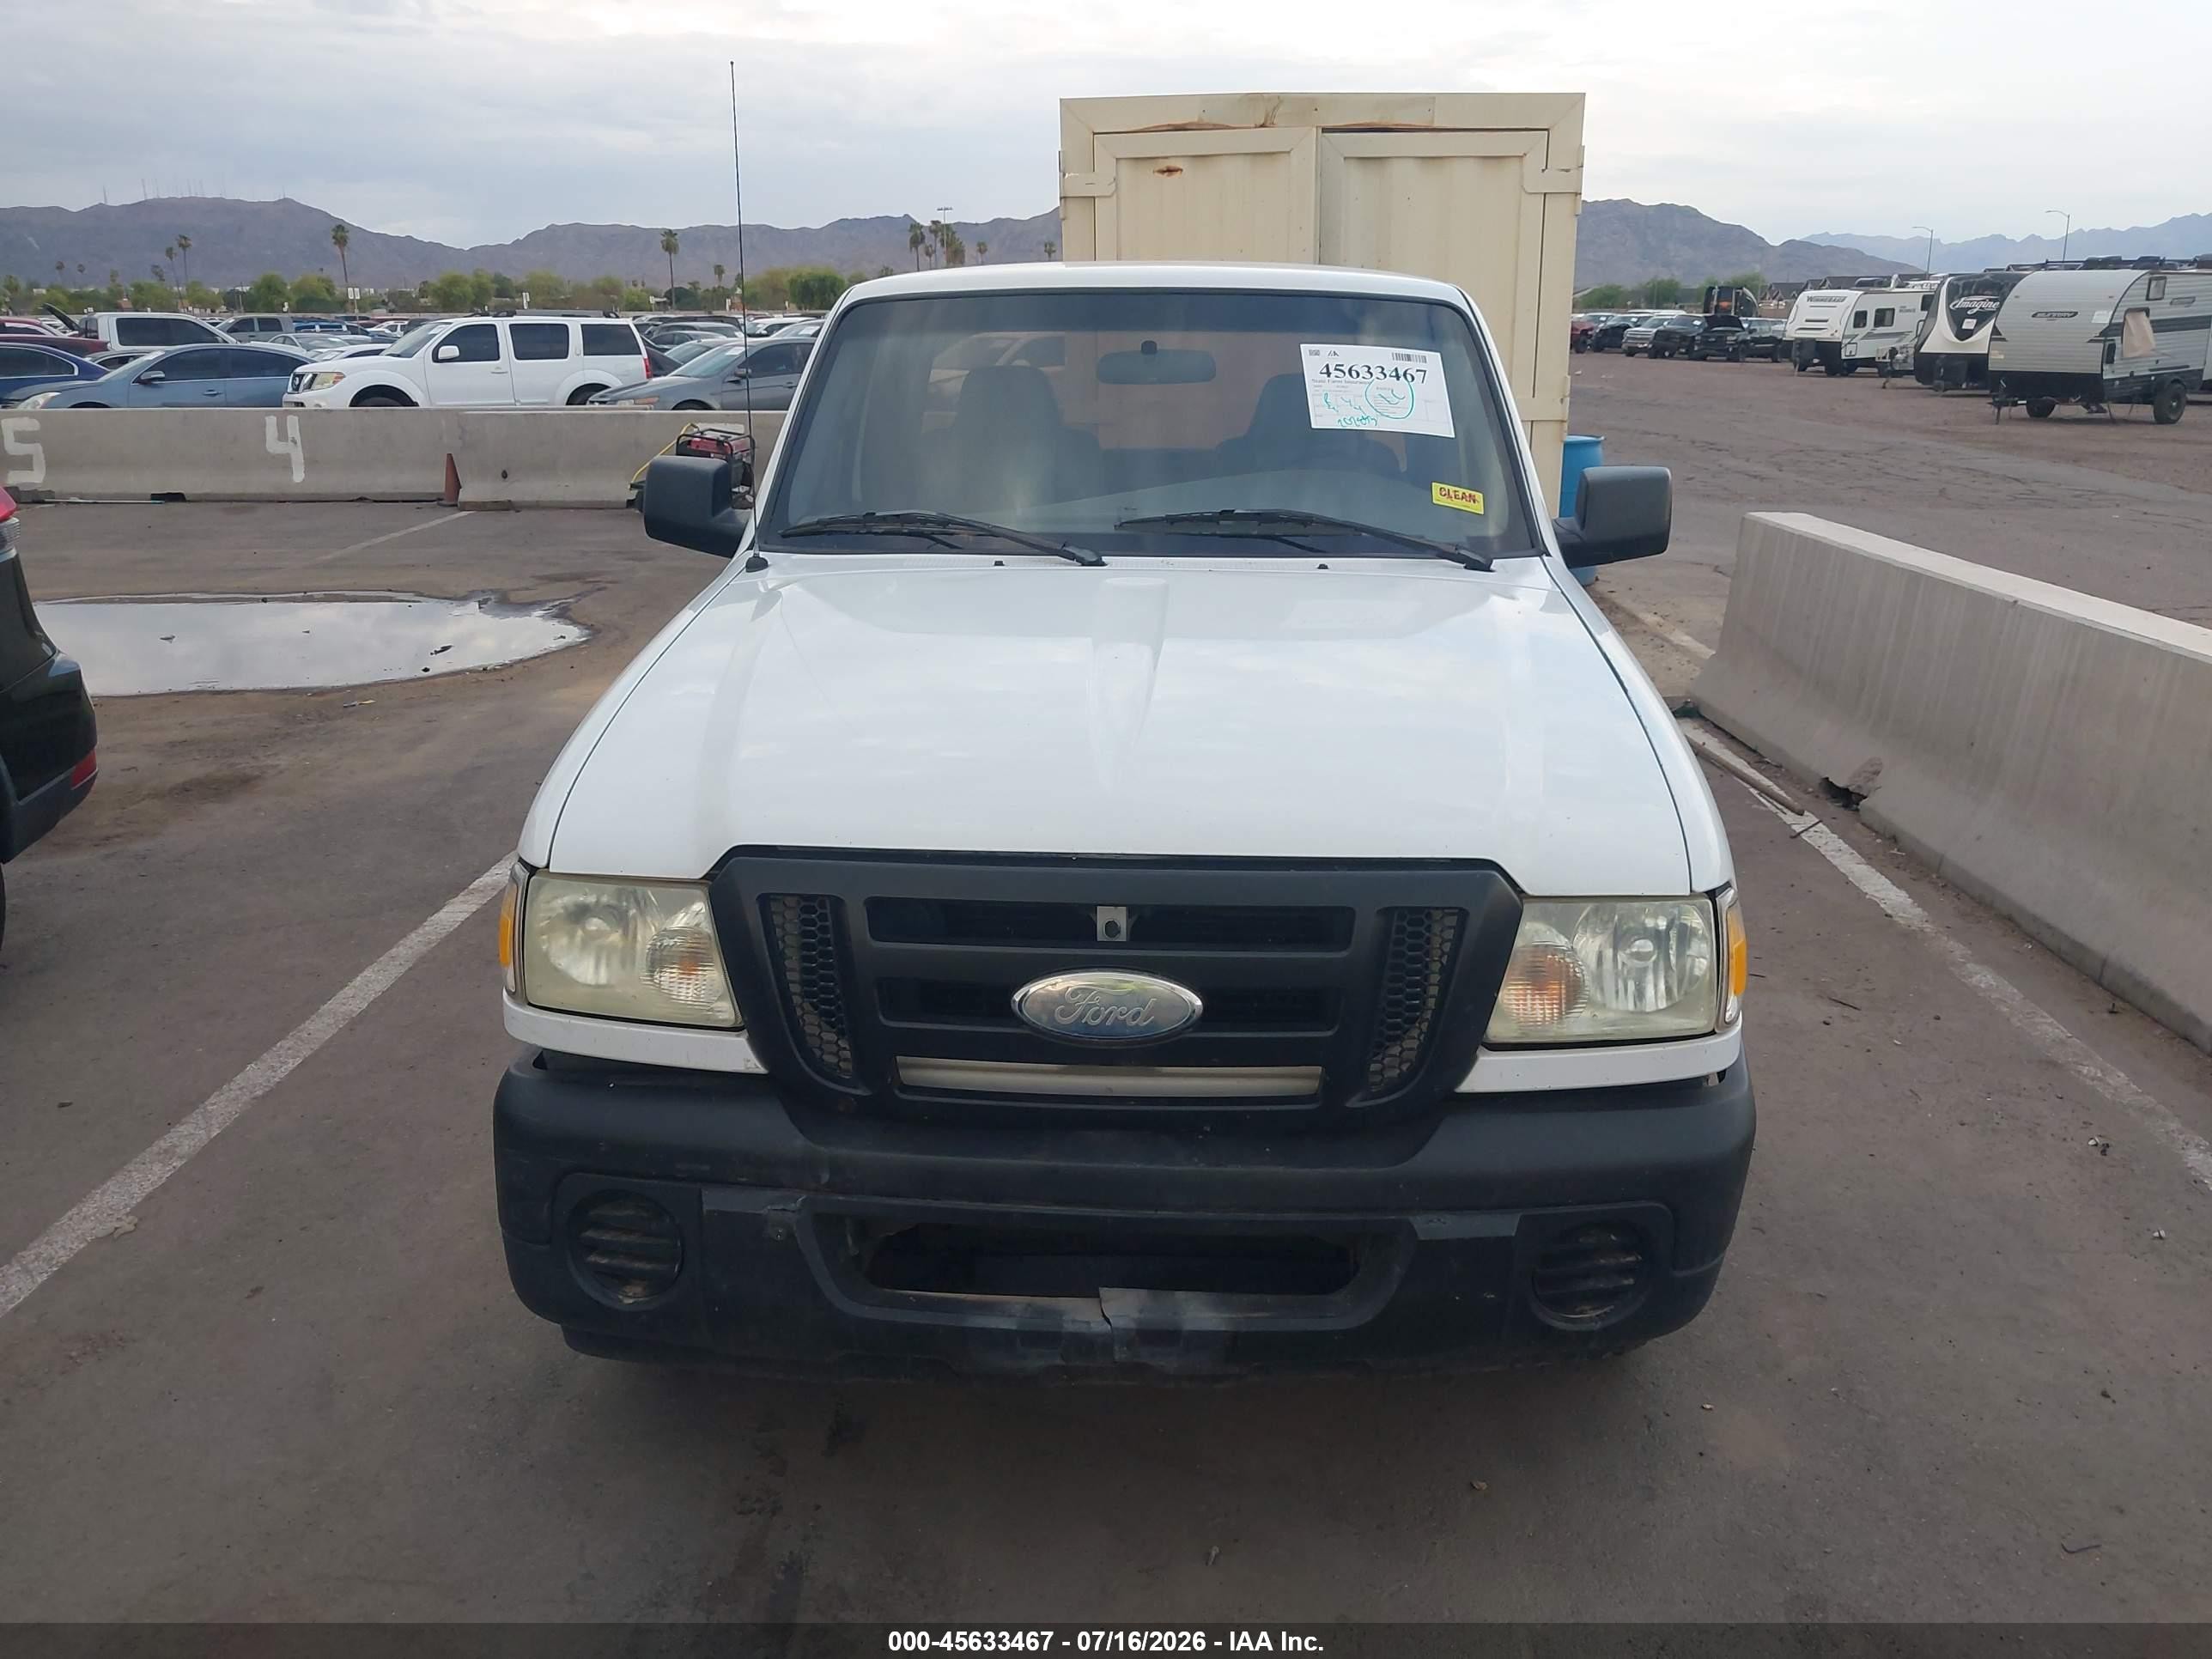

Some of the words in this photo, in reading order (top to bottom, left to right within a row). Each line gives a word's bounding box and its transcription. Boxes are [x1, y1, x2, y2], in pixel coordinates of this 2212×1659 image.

[1949, 295, 2000, 314] Imagine
[1319, 362, 1427, 385] 45633467
[1, 416, 46, 483] 5
[264, 415, 305, 483] 4
[1439, 486, 1476, 504] CLEAN
[1054, 985, 1158, 1027] Ford
